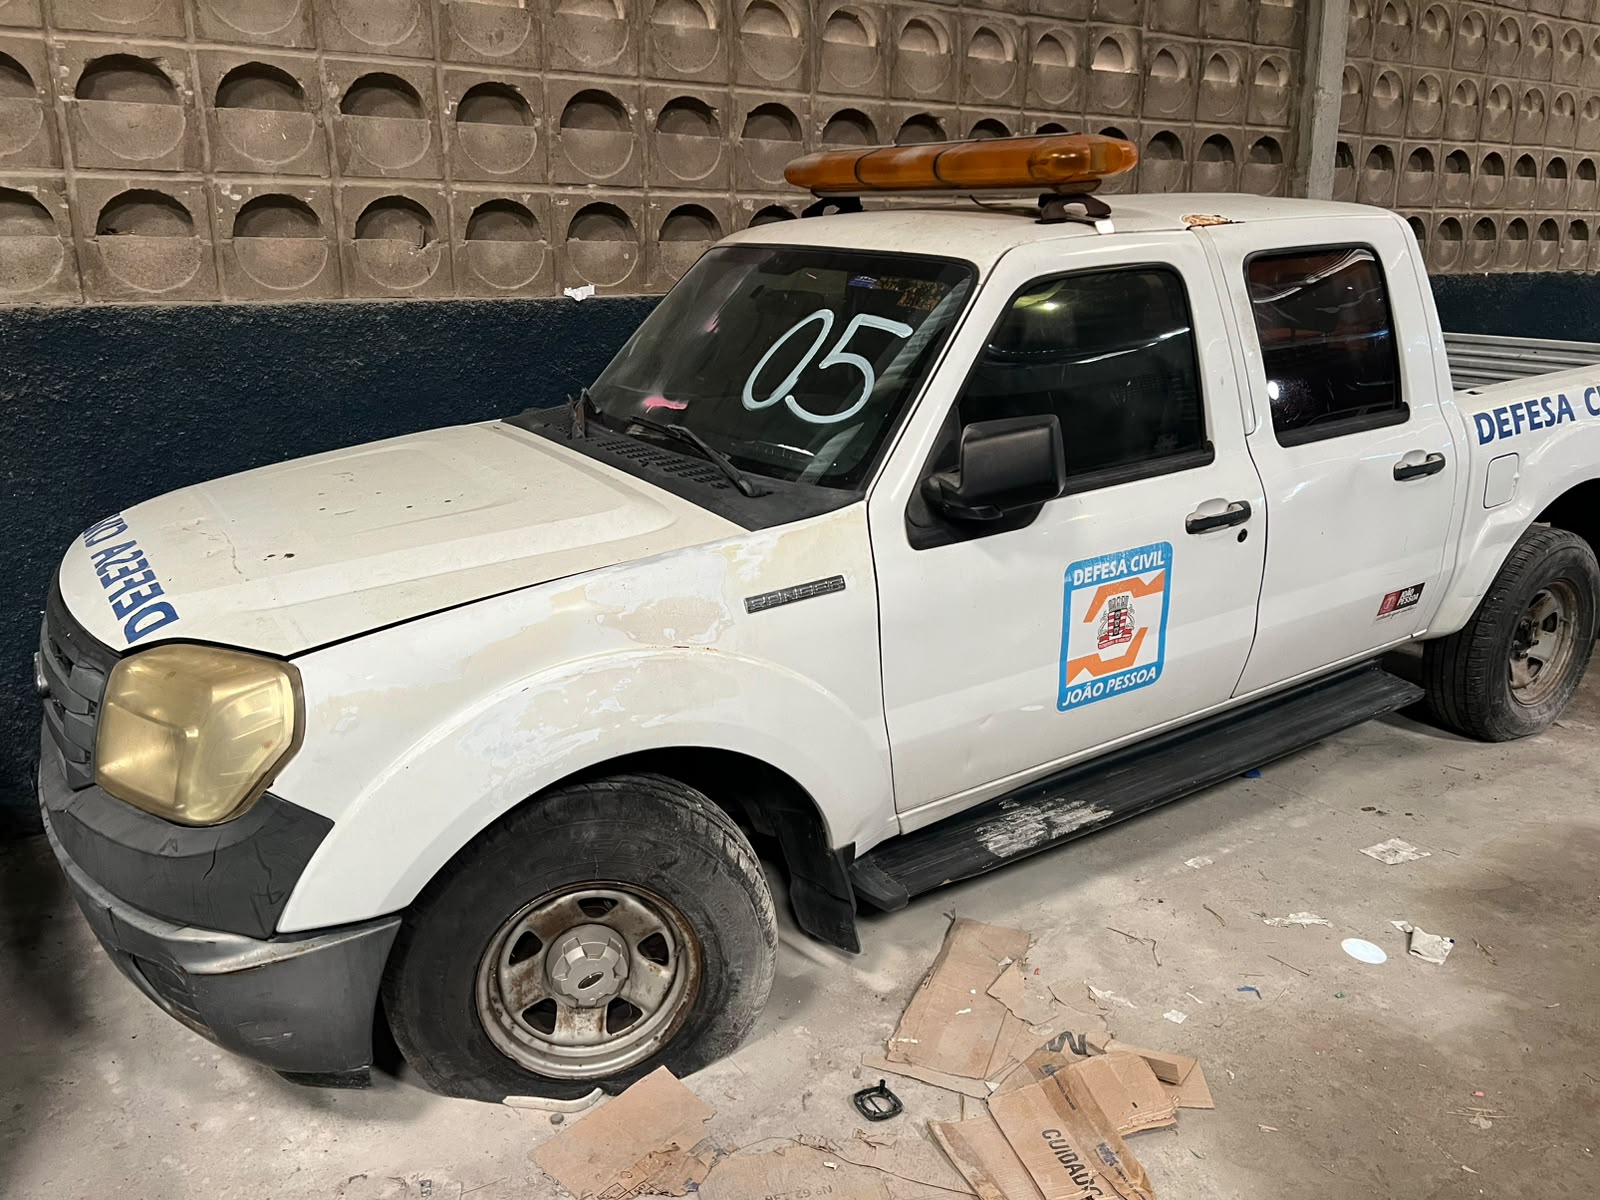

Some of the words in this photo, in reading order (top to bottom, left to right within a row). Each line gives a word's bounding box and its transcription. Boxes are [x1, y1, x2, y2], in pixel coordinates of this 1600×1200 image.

[742, 308, 914, 424] 05
[1473, 393, 1576, 446] DEFESA
[1583, 385, 1600, 417] C
[1073, 558, 1128, 587] DEFESA
[1130, 550, 1165, 572] CIVIL
[748, 577, 846, 611] RANGER
[1062, 682, 1104, 707] JOÃO
[1106, 666, 1156, 694] PESSOA
